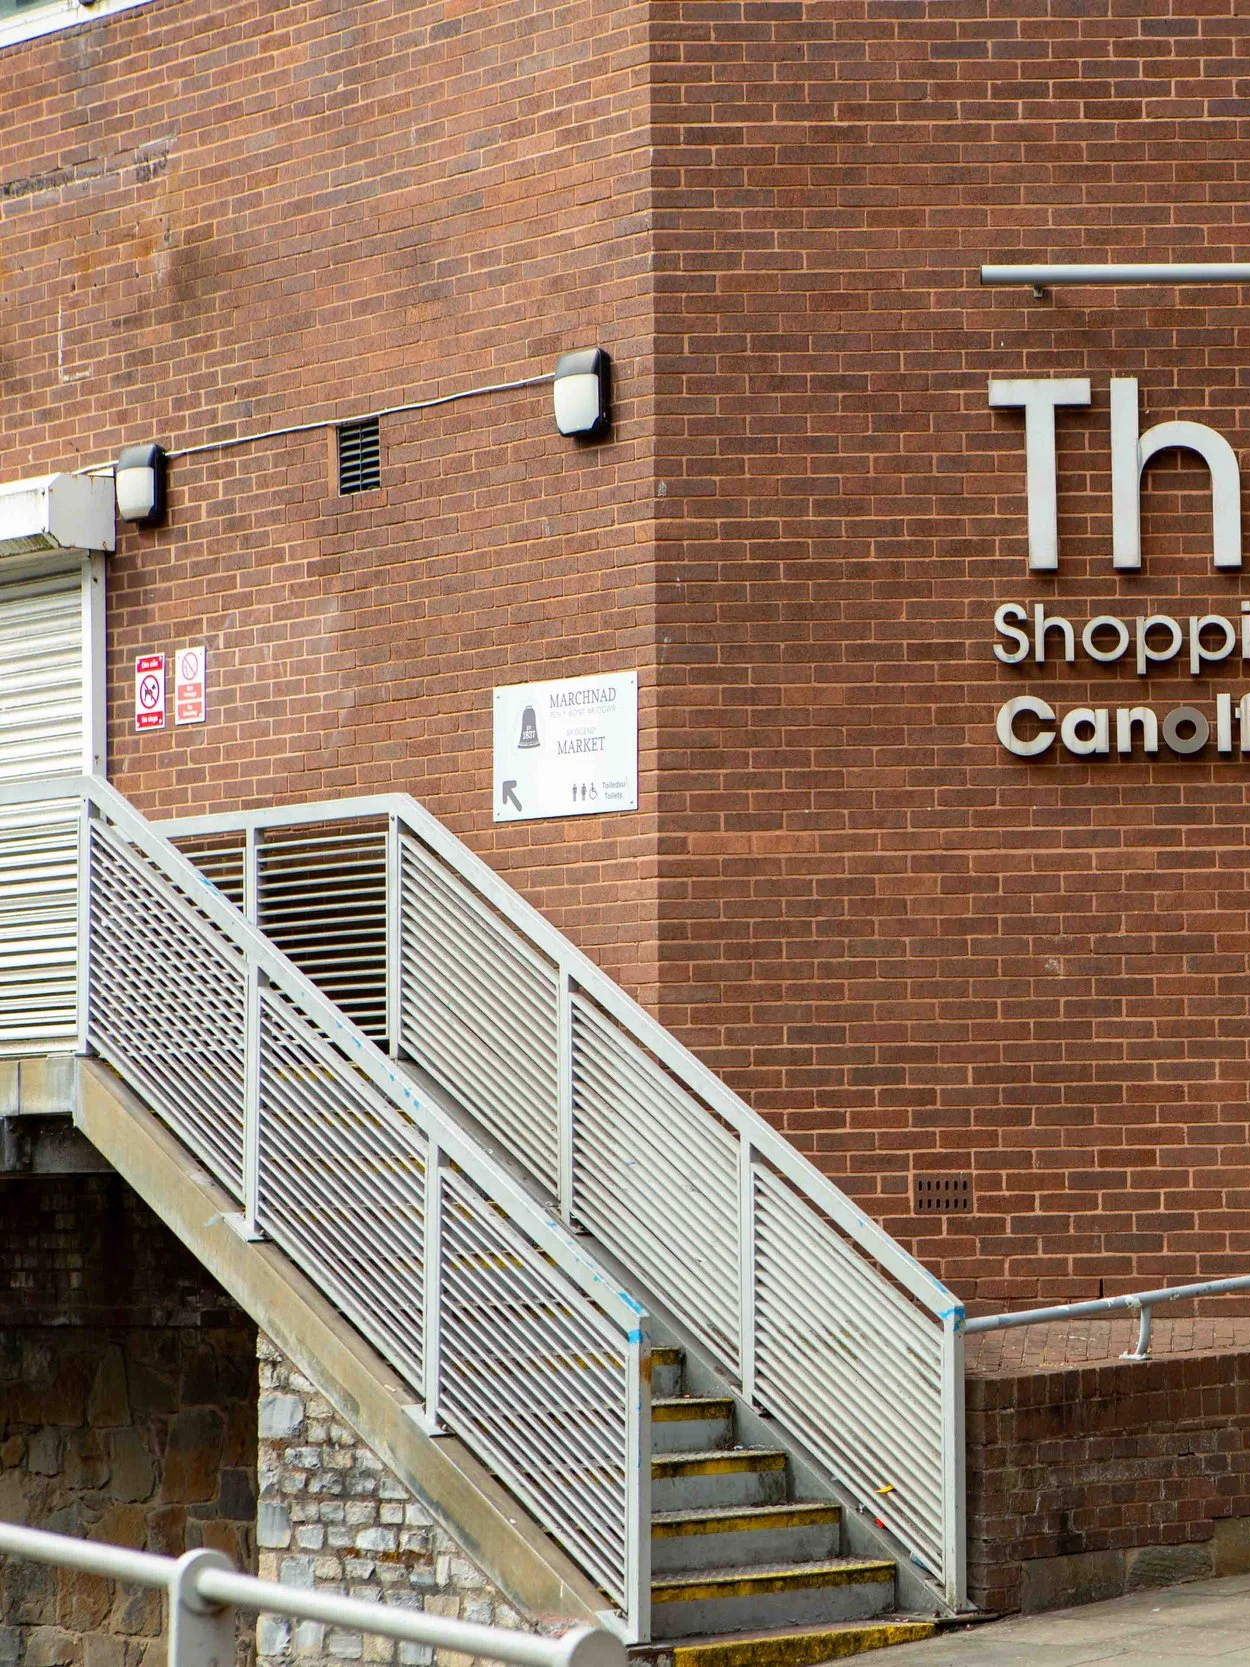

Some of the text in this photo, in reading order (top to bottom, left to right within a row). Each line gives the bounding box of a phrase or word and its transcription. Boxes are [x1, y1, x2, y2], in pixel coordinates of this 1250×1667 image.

[549, 687, 617, 708] MARCHNAD
[557, 736, 606, 755] MARKET
[604, 792, 623, 800] Toilets
